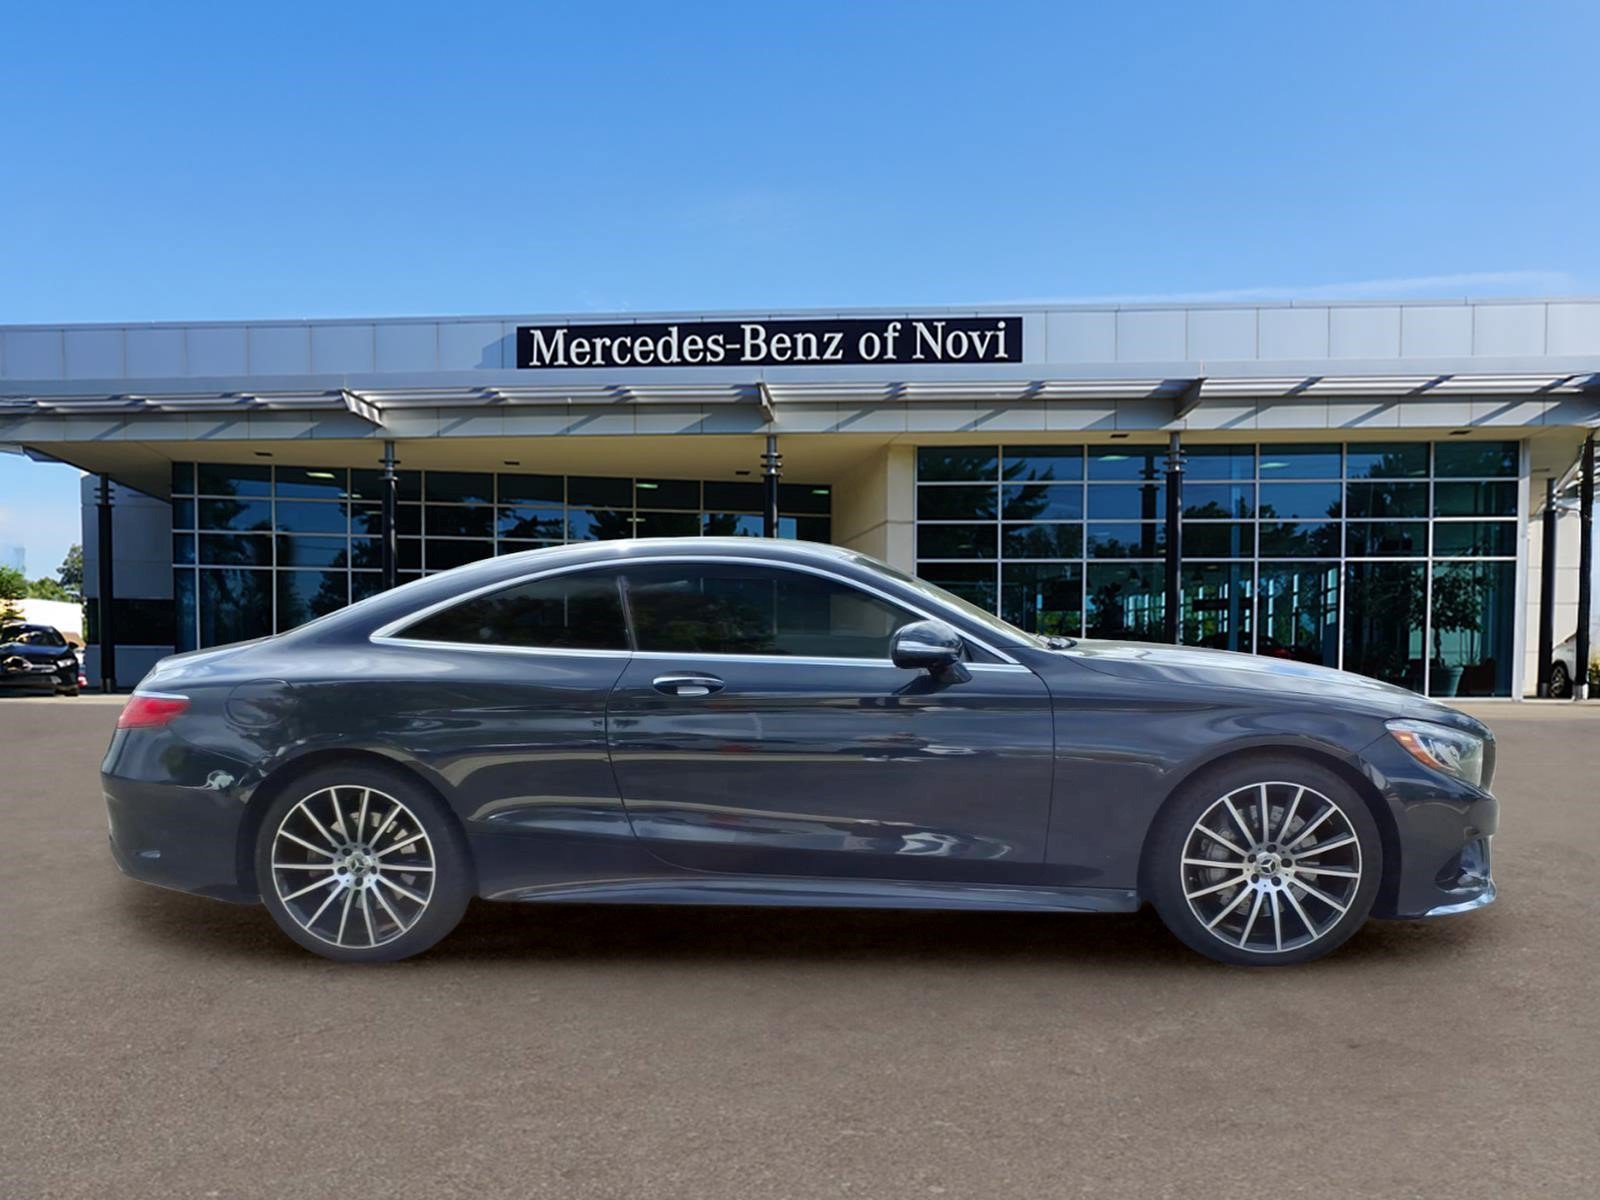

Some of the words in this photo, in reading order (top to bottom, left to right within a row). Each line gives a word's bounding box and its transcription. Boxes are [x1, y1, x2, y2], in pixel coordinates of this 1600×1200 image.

[528, 324, 843, 366] Mercedes-Benz
[858, 321, 901, 360] of
[911, 320, 1009, 360] Novi
